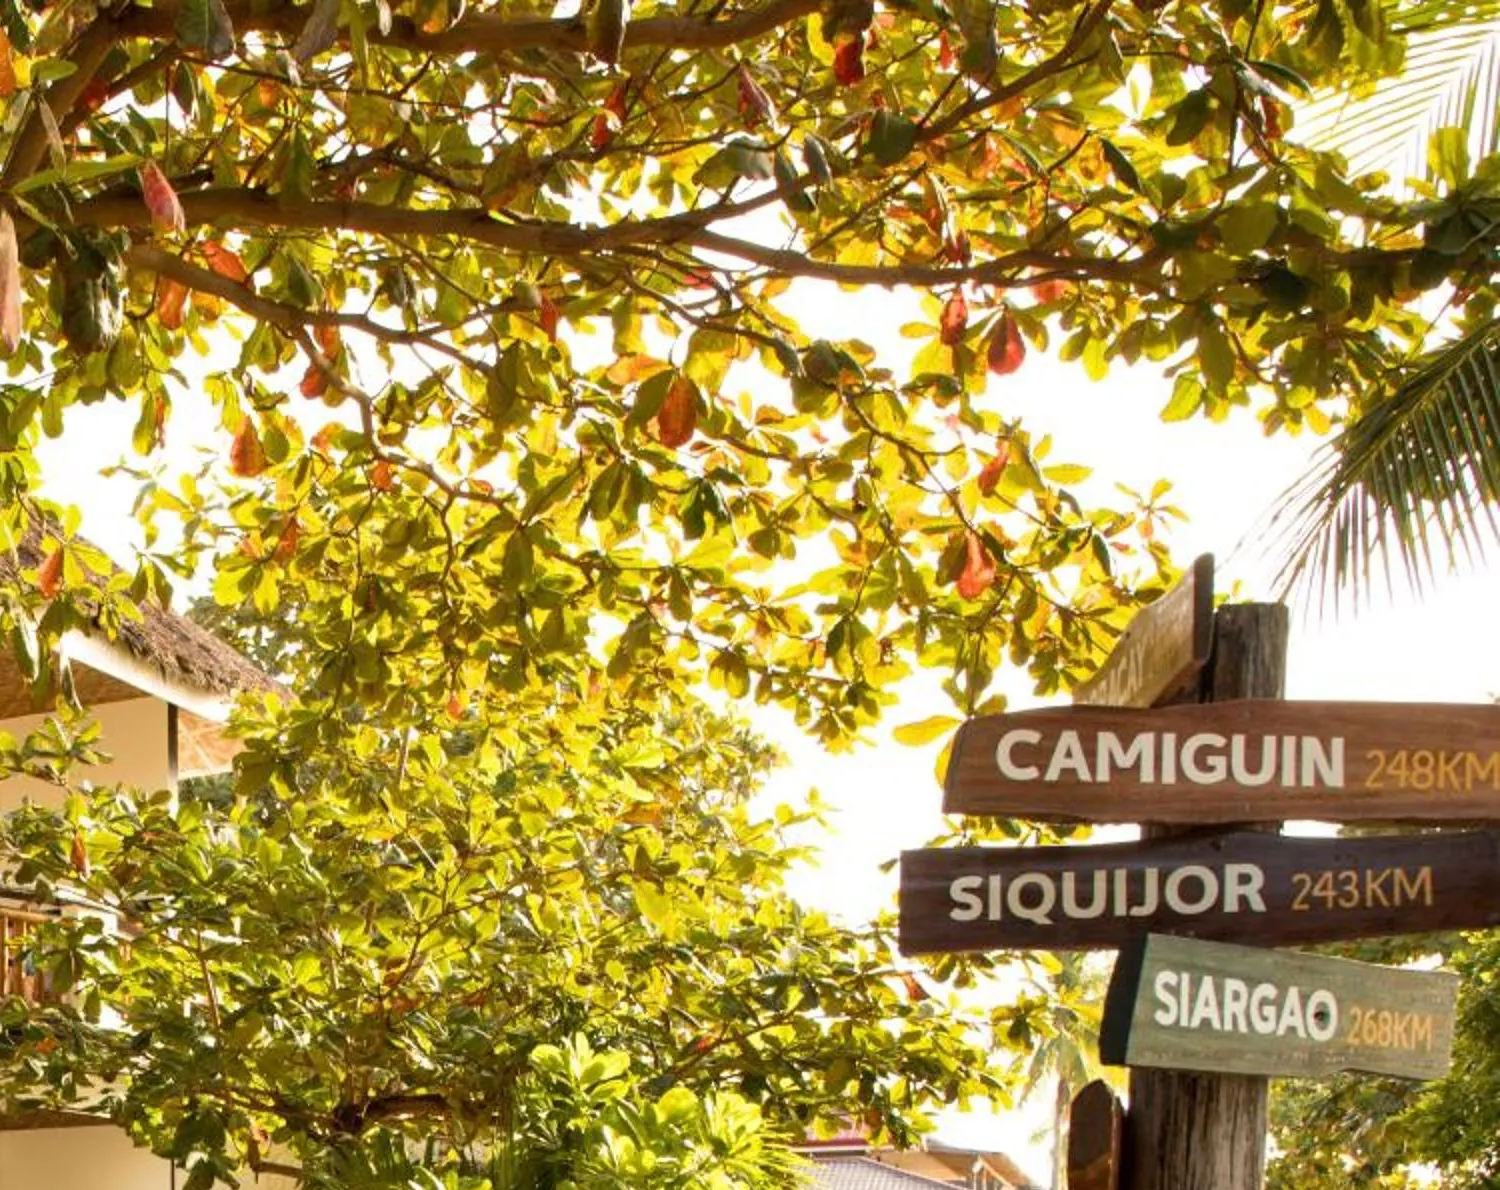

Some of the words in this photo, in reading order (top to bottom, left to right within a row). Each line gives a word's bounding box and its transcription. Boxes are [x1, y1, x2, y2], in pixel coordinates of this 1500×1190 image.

[995, 729, 1345, 787] CAMIGUIN
[1365, 749, 1500, 791] 248KM
[949, 862, 1267, 924] SIQUIJOR
[1290, 865, 1434, 912] 243KM
[1152, 969, 1339, 1043] SIARGAO
[1347, 1007, 1432, 1052] 268KM
